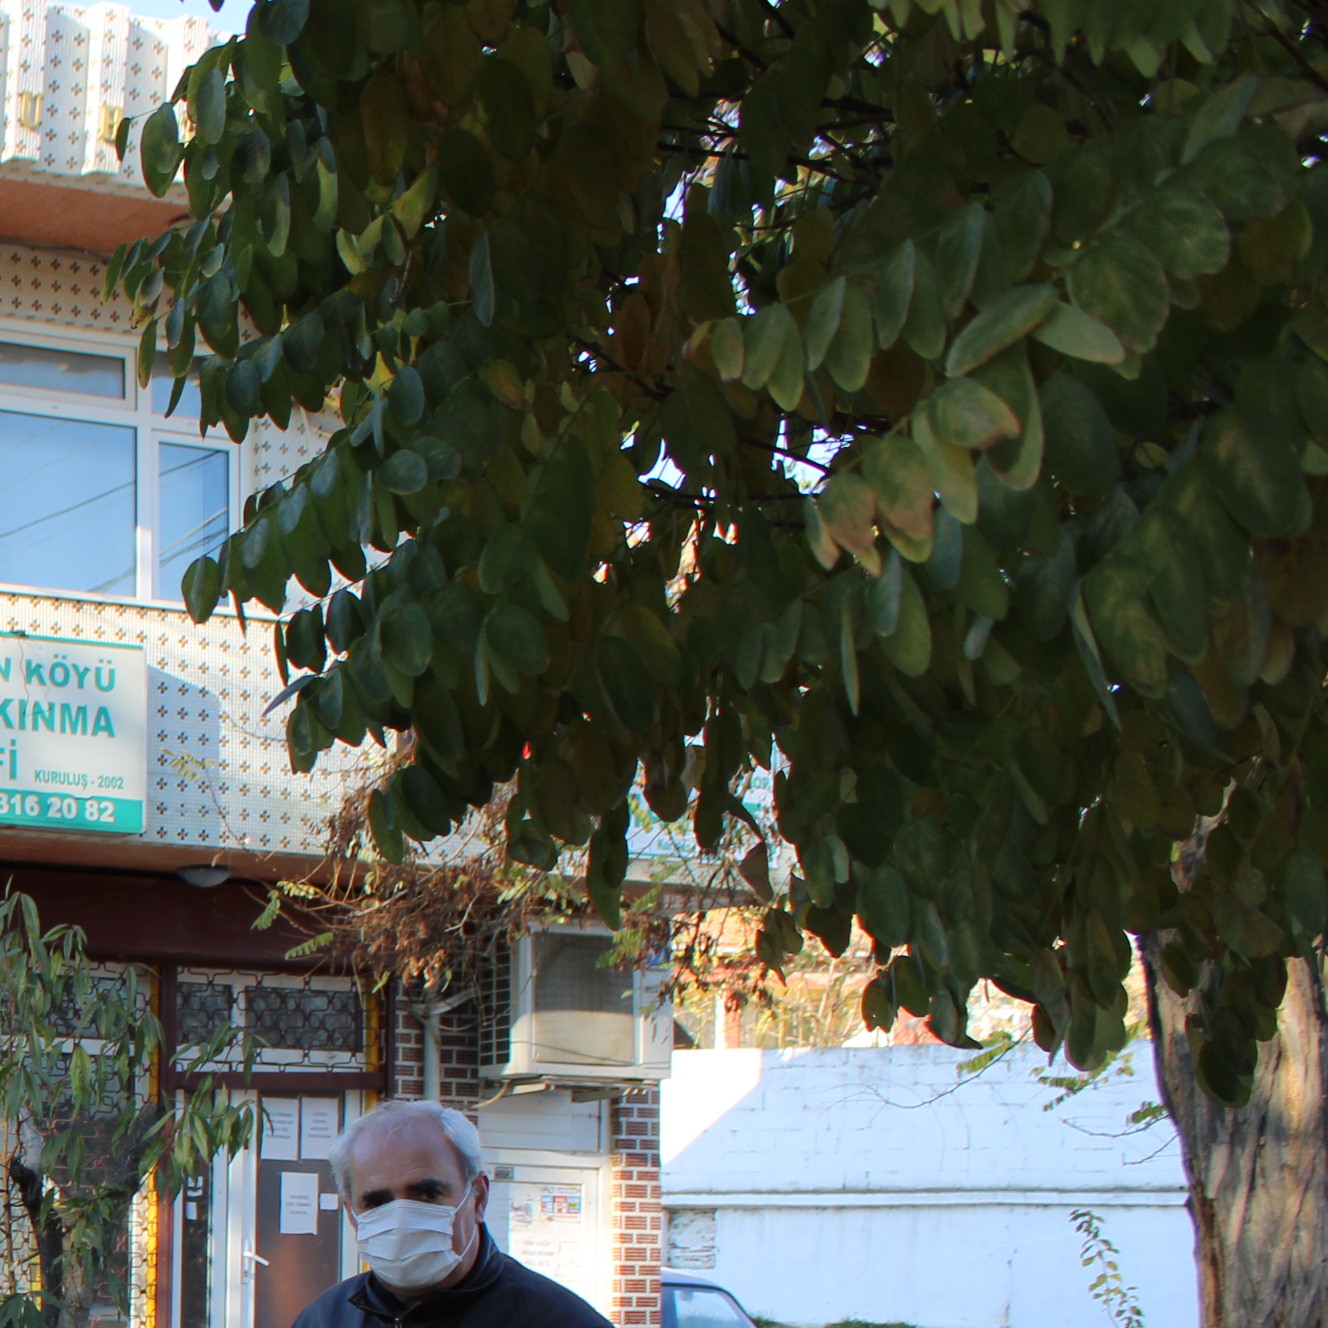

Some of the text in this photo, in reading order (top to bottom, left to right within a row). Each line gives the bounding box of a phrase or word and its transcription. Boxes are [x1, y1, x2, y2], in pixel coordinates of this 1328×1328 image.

[26, 653, 117, 692] KÖYÜ
[34, 769, 88, 790] KURULUŞ
[97, 775, 124, 790] 2002
[46, 796, 78, 819] 20
[84, 799, 116, 823] 82
